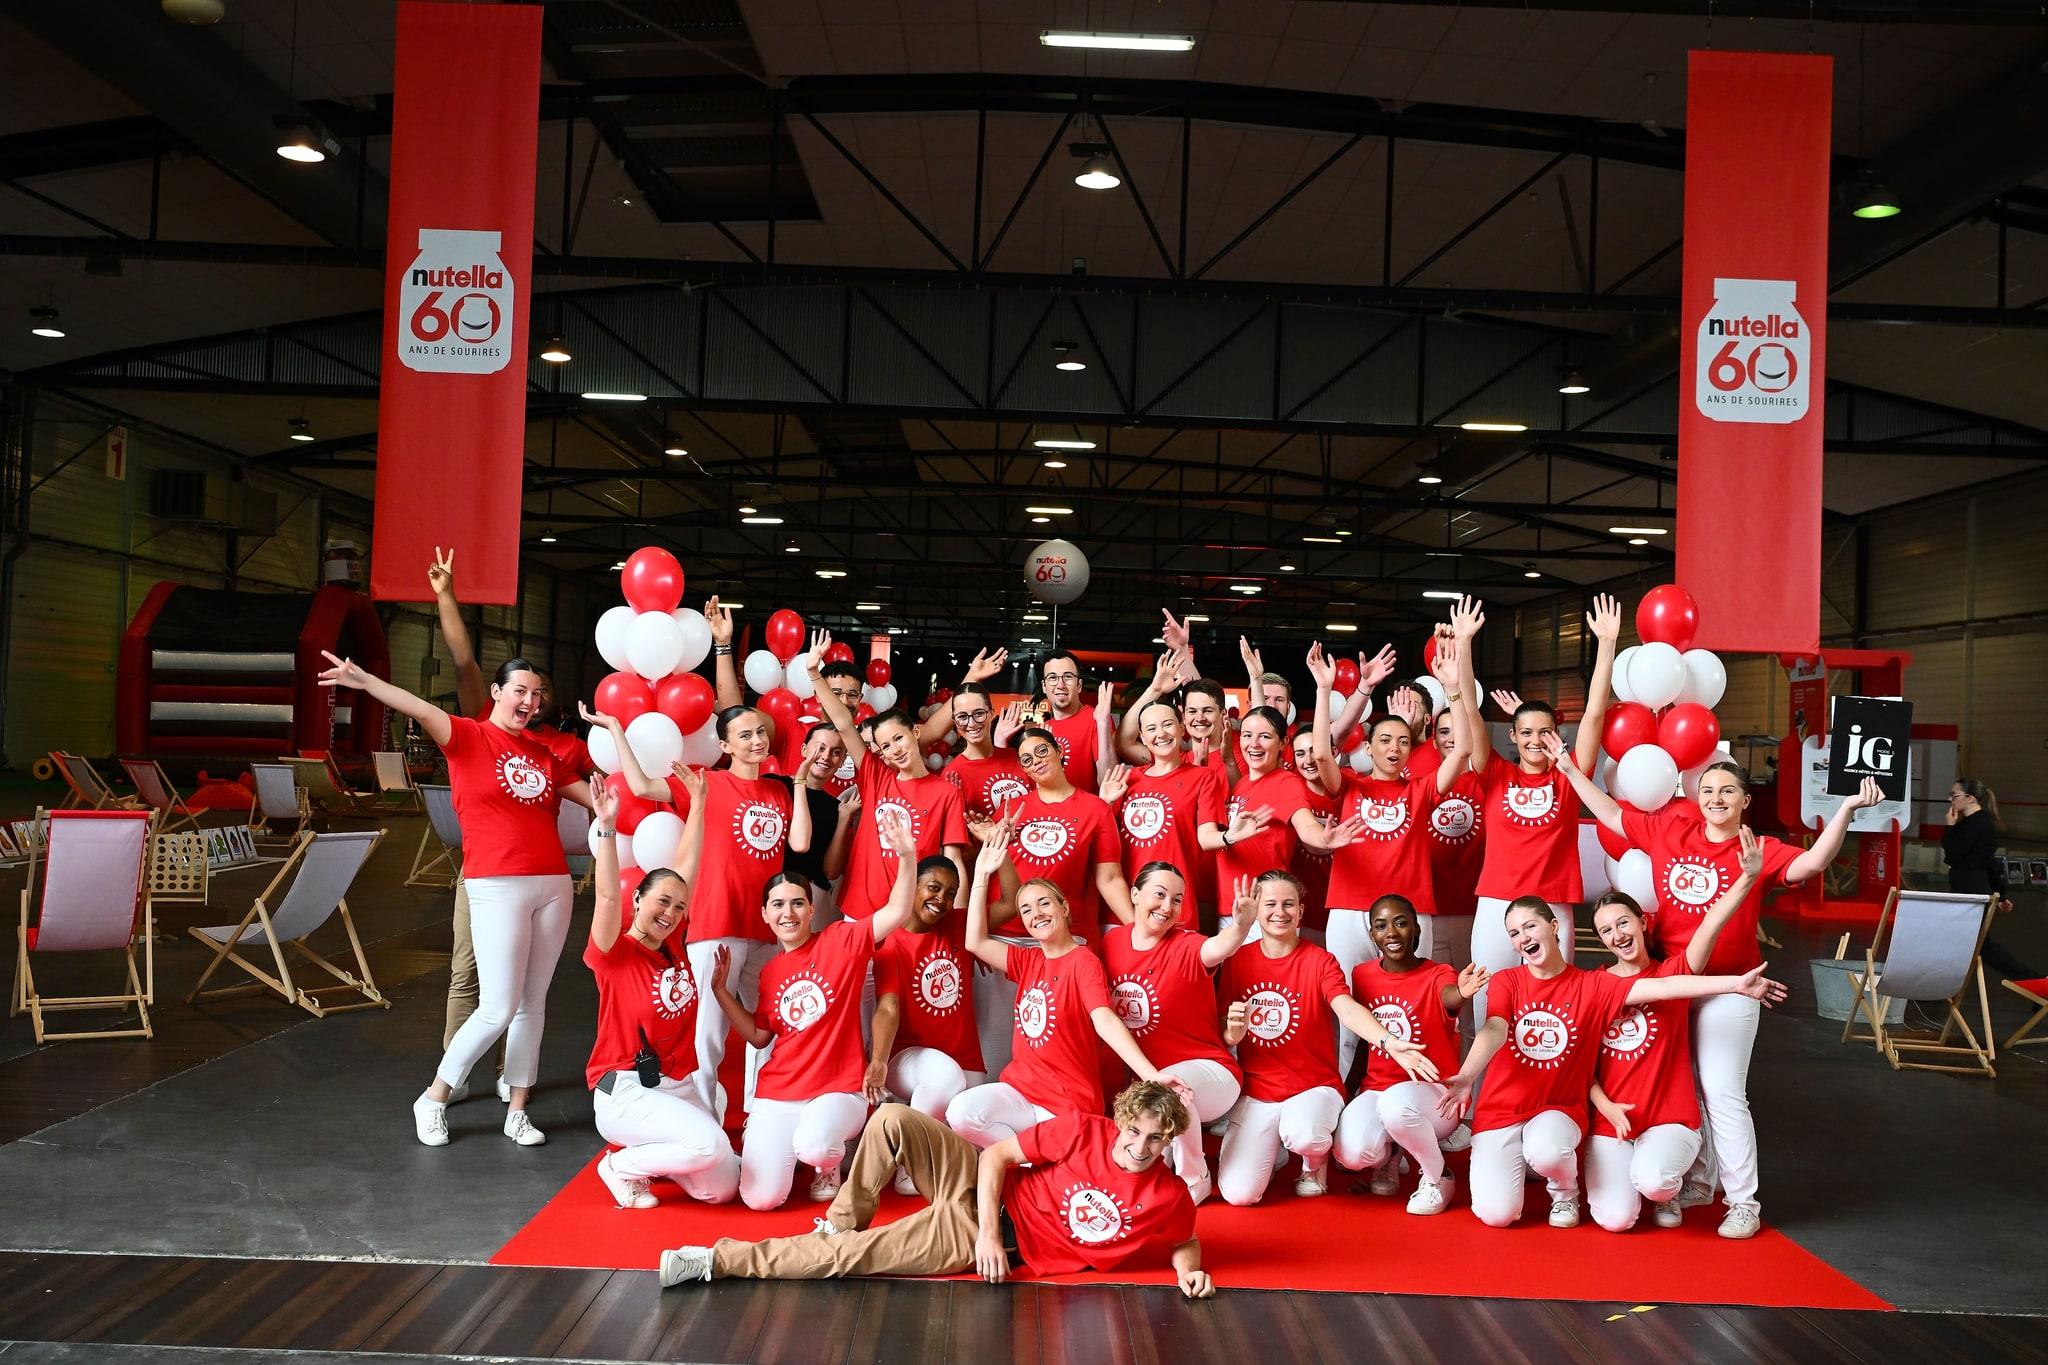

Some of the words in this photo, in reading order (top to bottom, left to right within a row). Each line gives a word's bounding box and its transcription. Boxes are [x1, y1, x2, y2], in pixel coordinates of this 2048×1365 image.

[412, 264, 503, 288] nutella
[411, 292, 500, 344] 60
[1709, 314, 1798, 338] nutella
[408, 346, 429, 354] ANS
[434, 346, 446, 355] DE
[450, 346, 500, 356] SOURIRES
[1708, 341, 1798, 392] 60
[1707, 395, 1726, 404] ANS
[1731, 396, 1743, 404] DE
[1748, 396, 1798, 406] SOURIRES
[112, 442, 122, 478] 1
[1036, 556, 1066, 564] nutella
[1036, 565, 1066, 582] 60
[512, 770, 540, 788] 60
[993, 782, 1018, 794] nutella
[1130, 800, 1159, 808] nutella
[1514, 788, 1547, 806] 60
[750, 810, 777, 819] nutella
[1130, 809, 1158, 827] 60
[1368, 806, 1399, 821] 60
[1438, 810, 1467, 826] 60
[750, 819, 777, 839] 60
[1027, 829, 1059, 846] 60
[1675, 872, 1709, 894] 60
[925, 963, 952, 980] nutella
[783, 984, 813, 1004] nutella
[930, 973, 956, 998] 60
[1114, 989, 1143, 999] nutella
[789, 995, 818, 1022] 60
[1116, 999, 1142, 1018] 60
[1252, 998, 1284, 1007] nutella
[1022, 1004, 1040, 1025] 60
[1250, 1007, 1282, 1027] 60
[1373, 1011, 1402, 1019] nutella
[1523, 1019, 1559, 1028] nutella
[1523, 1028, 1559, 1048] 60
[1084, 1192, 1118, 1223] nutella
[1076, 1205, 1110, 1232] 60
